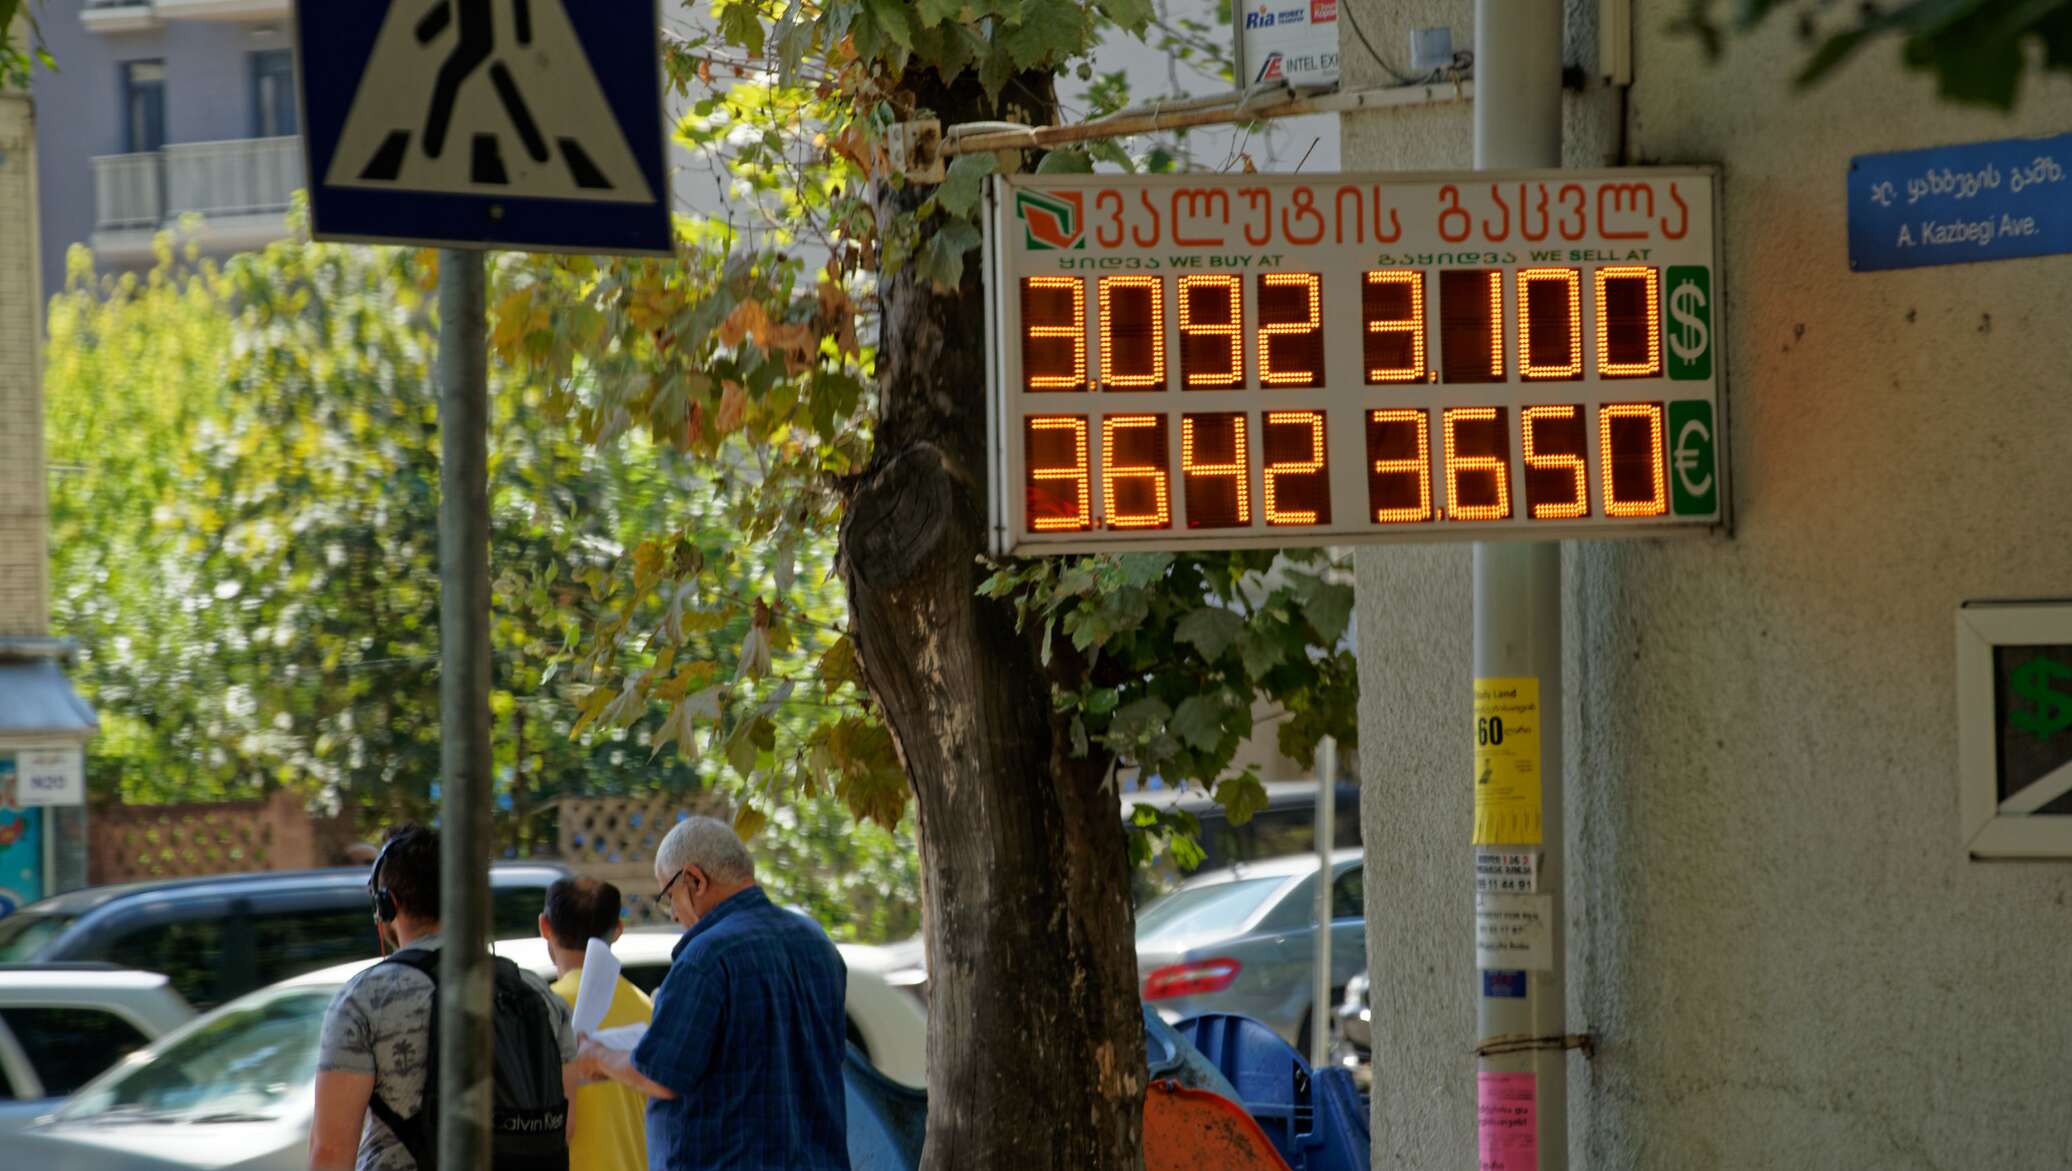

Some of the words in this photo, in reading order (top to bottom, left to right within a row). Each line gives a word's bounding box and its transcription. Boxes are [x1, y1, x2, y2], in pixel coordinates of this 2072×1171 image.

[1246, 6, 1275, 30] Ria
[1286, 56, 1317, 73] INTEL
[1095, 182, 1402, 249] ვალუტის
[1438, 181, 1689, 243] გაცვლა
[1897, 224, 1917, 247] A.
[1922, 216, 1995, 246] Kazbegi
[2000, 213, 2040, 237] Ave.
[1169, 256, 1203, 268] WE
[1209, 255, 1253, 268] BUY
[1258, 254, 1284, 268] AT
[1530, 250, 1562, 263] WE
[1569, 249, 1619, 262] SELL
[1624, 248, 1653, 262] AT
[1028, 273, 1321, 388] 3.092
[1368, 266, 1661, 384] 3.100
[1031, 412, 1325, 530] 3.642
[1373, 403, 1666, 523] 3.650
[1478, 715, 1503, 747] 60
[498, 1112, 543, 1132] alvin
